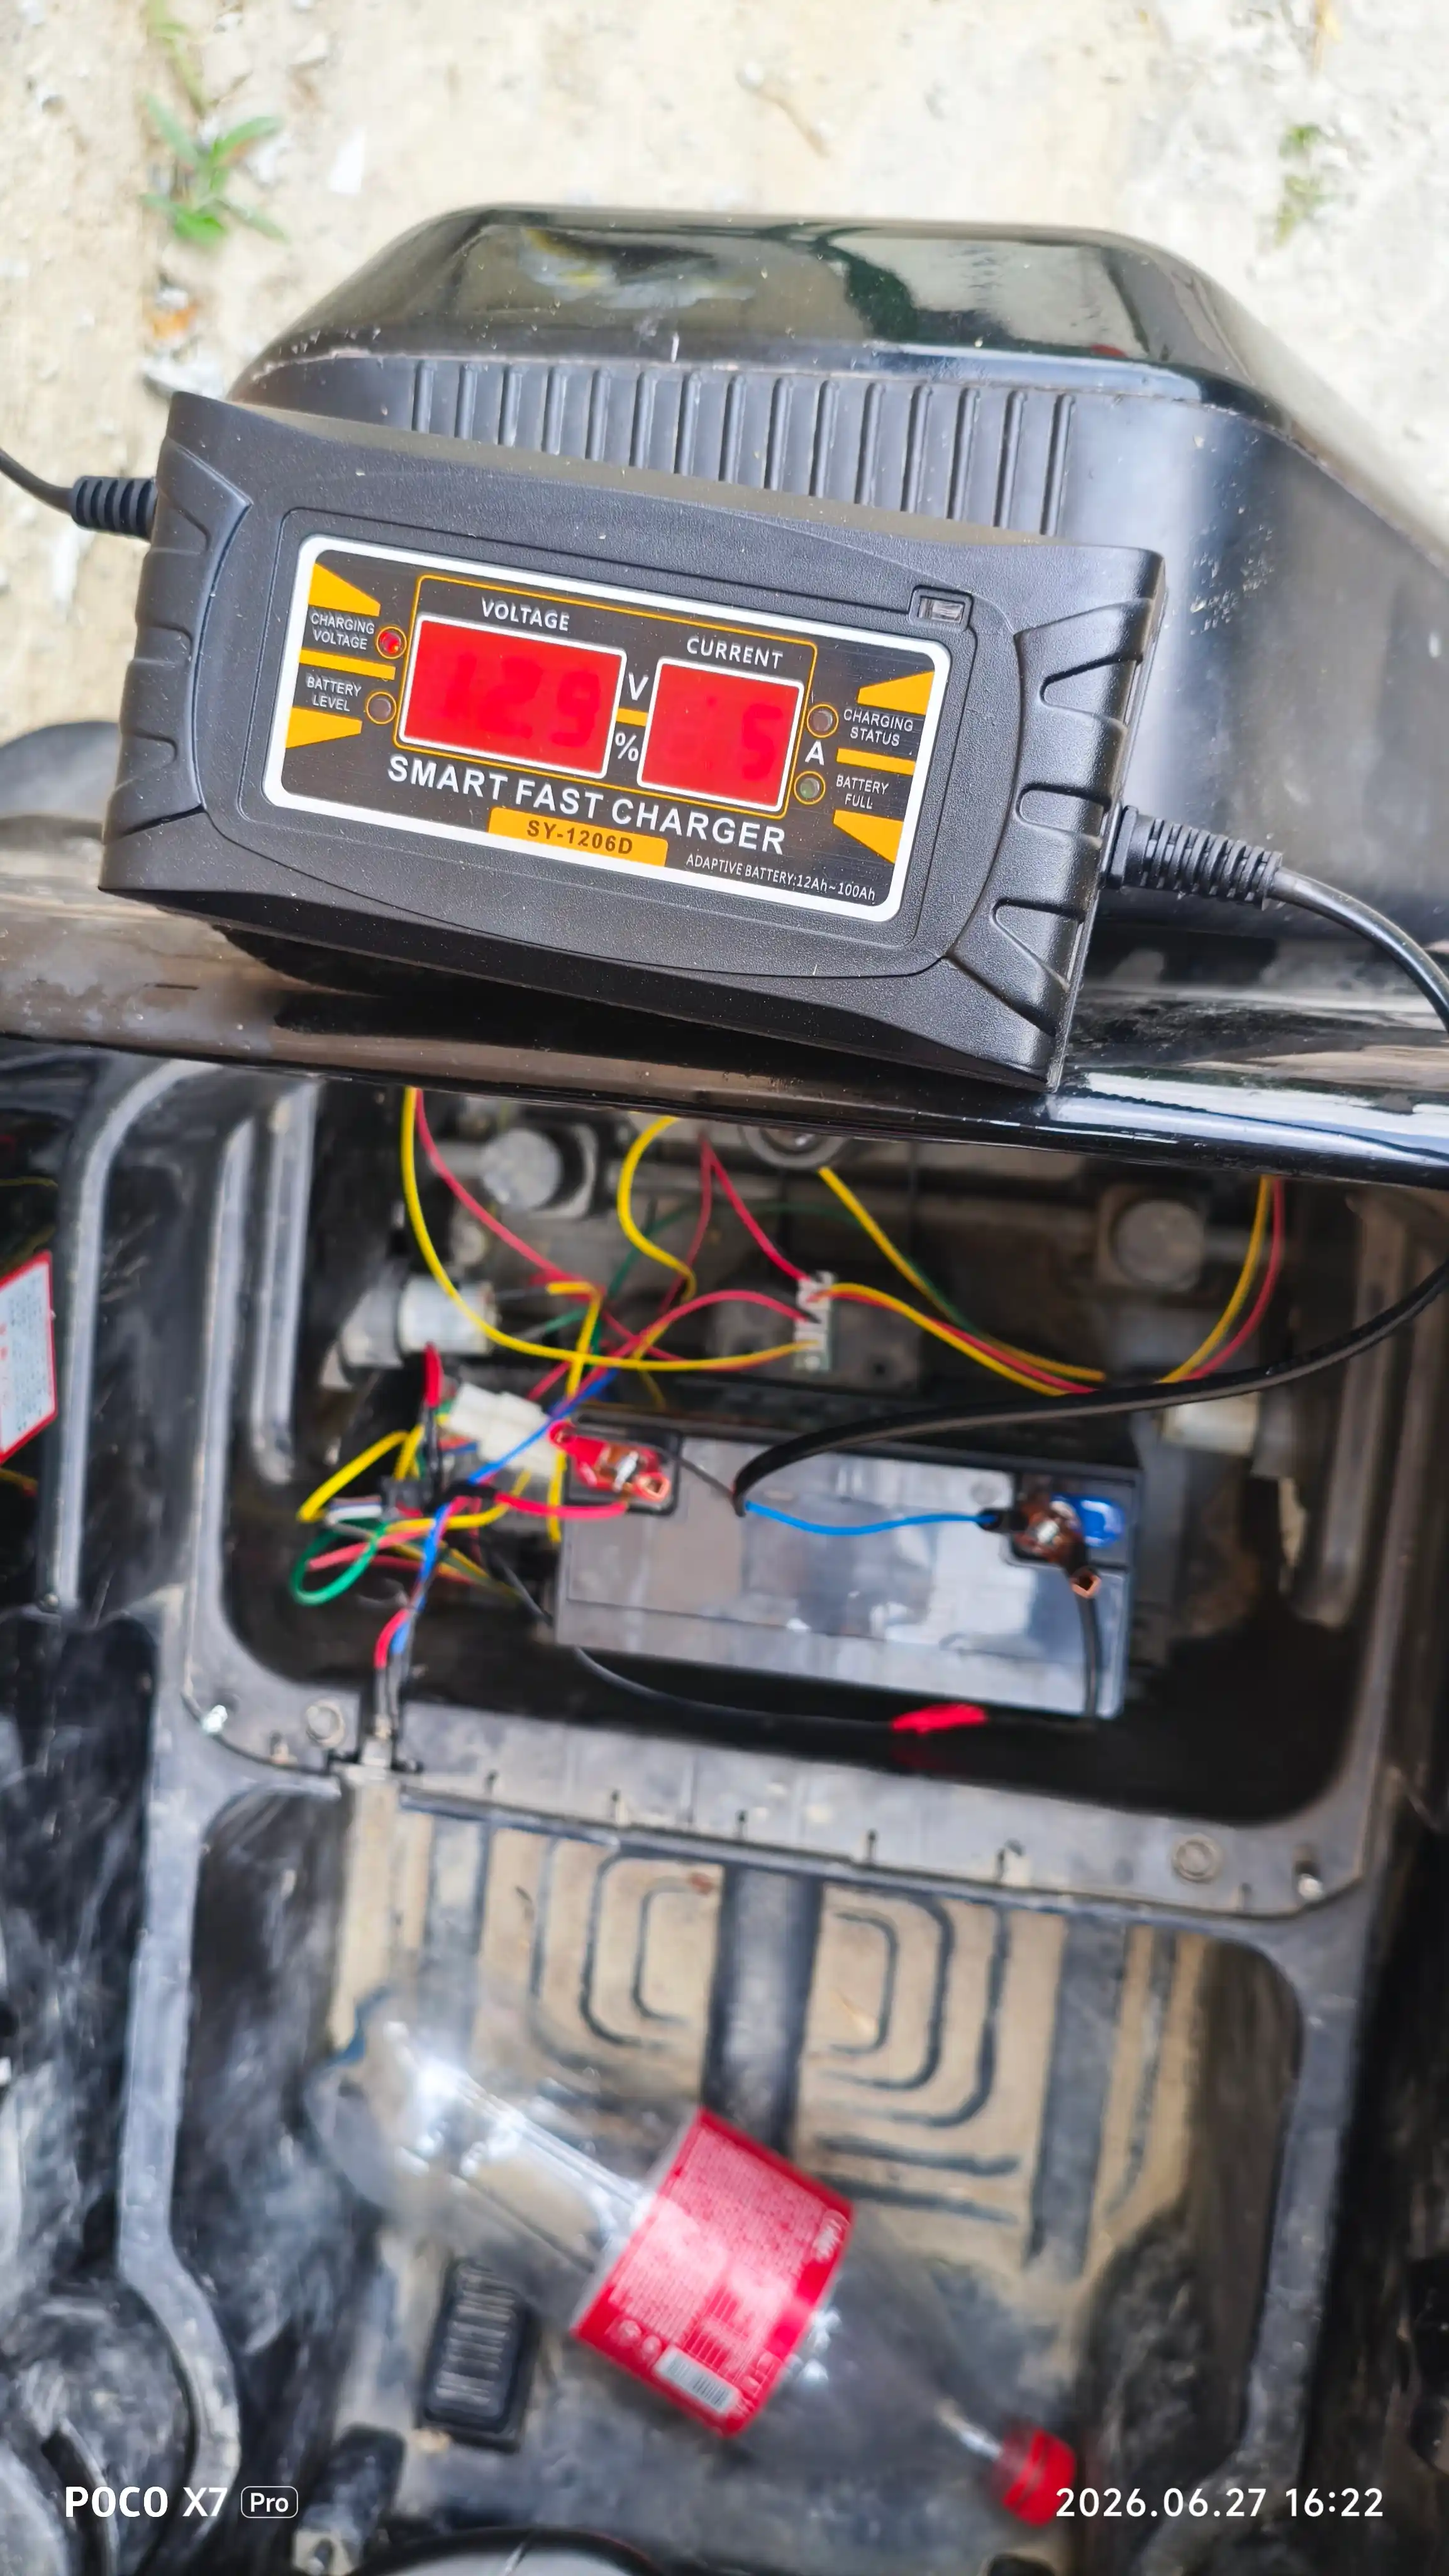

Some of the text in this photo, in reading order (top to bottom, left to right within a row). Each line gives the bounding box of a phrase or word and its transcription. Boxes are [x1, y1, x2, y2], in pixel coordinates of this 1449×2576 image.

[310, 612, 375, 635] CHARGING
[480, 596, 570, 632] VOLTAGE
[313, 629, 368, 650] VOLTAGE
[686, 635, 784, 669] CURRENT
[306, 676, 362, 698] BATTERY
[628, 673, 649, 701] V
[313, 695, 350, 712] LEVEL
[843, 708, 914, 732] CHARGING
[850, 726, 900, 747] STATUS
[804, 741, 825, 765] A
[836, 774, 890, 796] BATTERY
[387, 755, 785, 855] SMART FAST CHARGER
[845, 792, 873, 810] FULL
[526, 818, 633, 856] SY-1206D
[686, 853, 742, 877] ADAPTIVE
